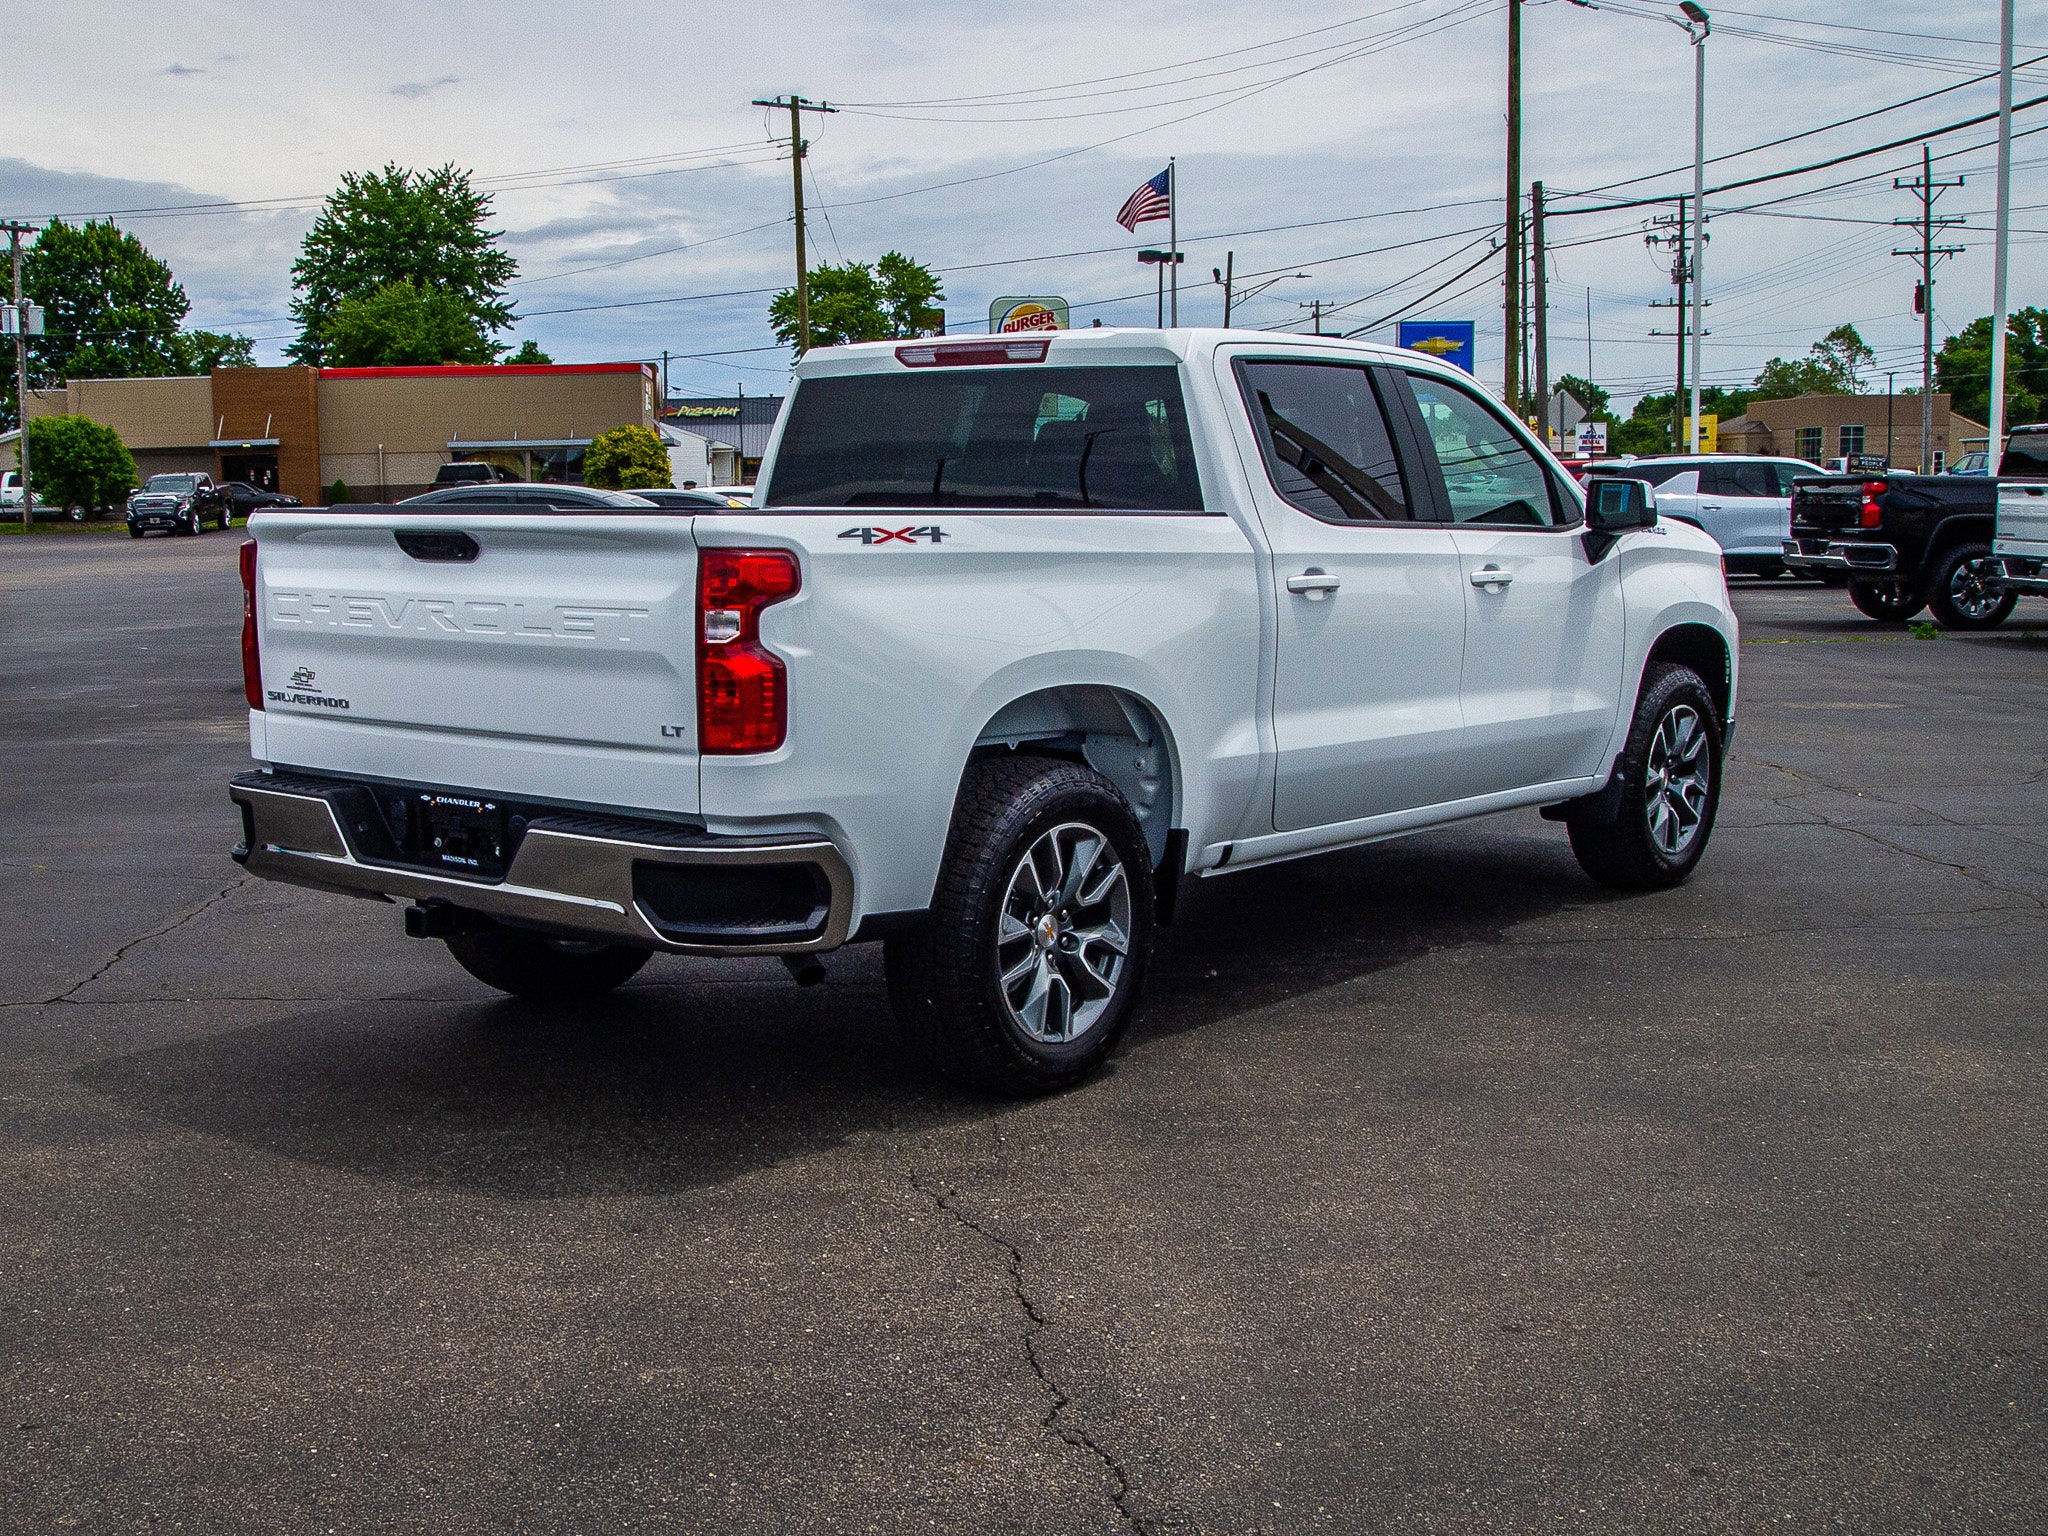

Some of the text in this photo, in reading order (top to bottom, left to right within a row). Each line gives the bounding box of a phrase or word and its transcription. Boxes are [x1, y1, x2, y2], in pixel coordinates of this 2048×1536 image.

[1003, 311, 1055, 333] BURGER
[677, 405, 741, 417] Pizza Hut
[272, 592, 650, 641] CHEVROLET
[267, 690, 350, 709] SILVERADO
[660, 725, 685, 738] LT
[436, 796, 481, 808] CHANDLER
